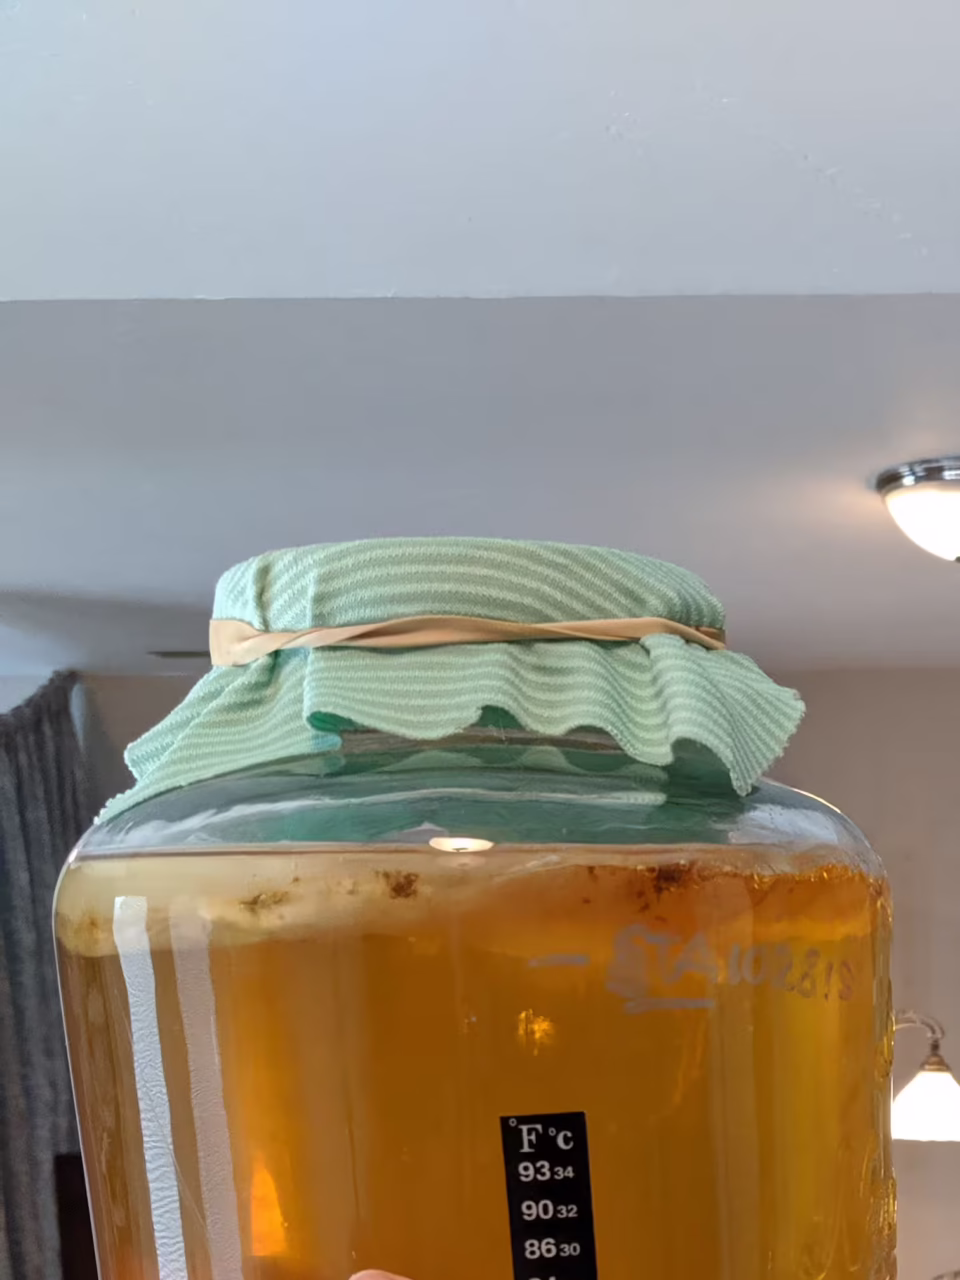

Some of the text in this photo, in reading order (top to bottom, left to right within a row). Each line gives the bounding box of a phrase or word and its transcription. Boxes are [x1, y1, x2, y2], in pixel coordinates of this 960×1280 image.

[509, 1117, 543, 1153] °F
[518, 1160, 574, 1182] 93 34
[521, 1199, 578, 1221] 90 32
[524, 1237, 581, 1260] 86 30
